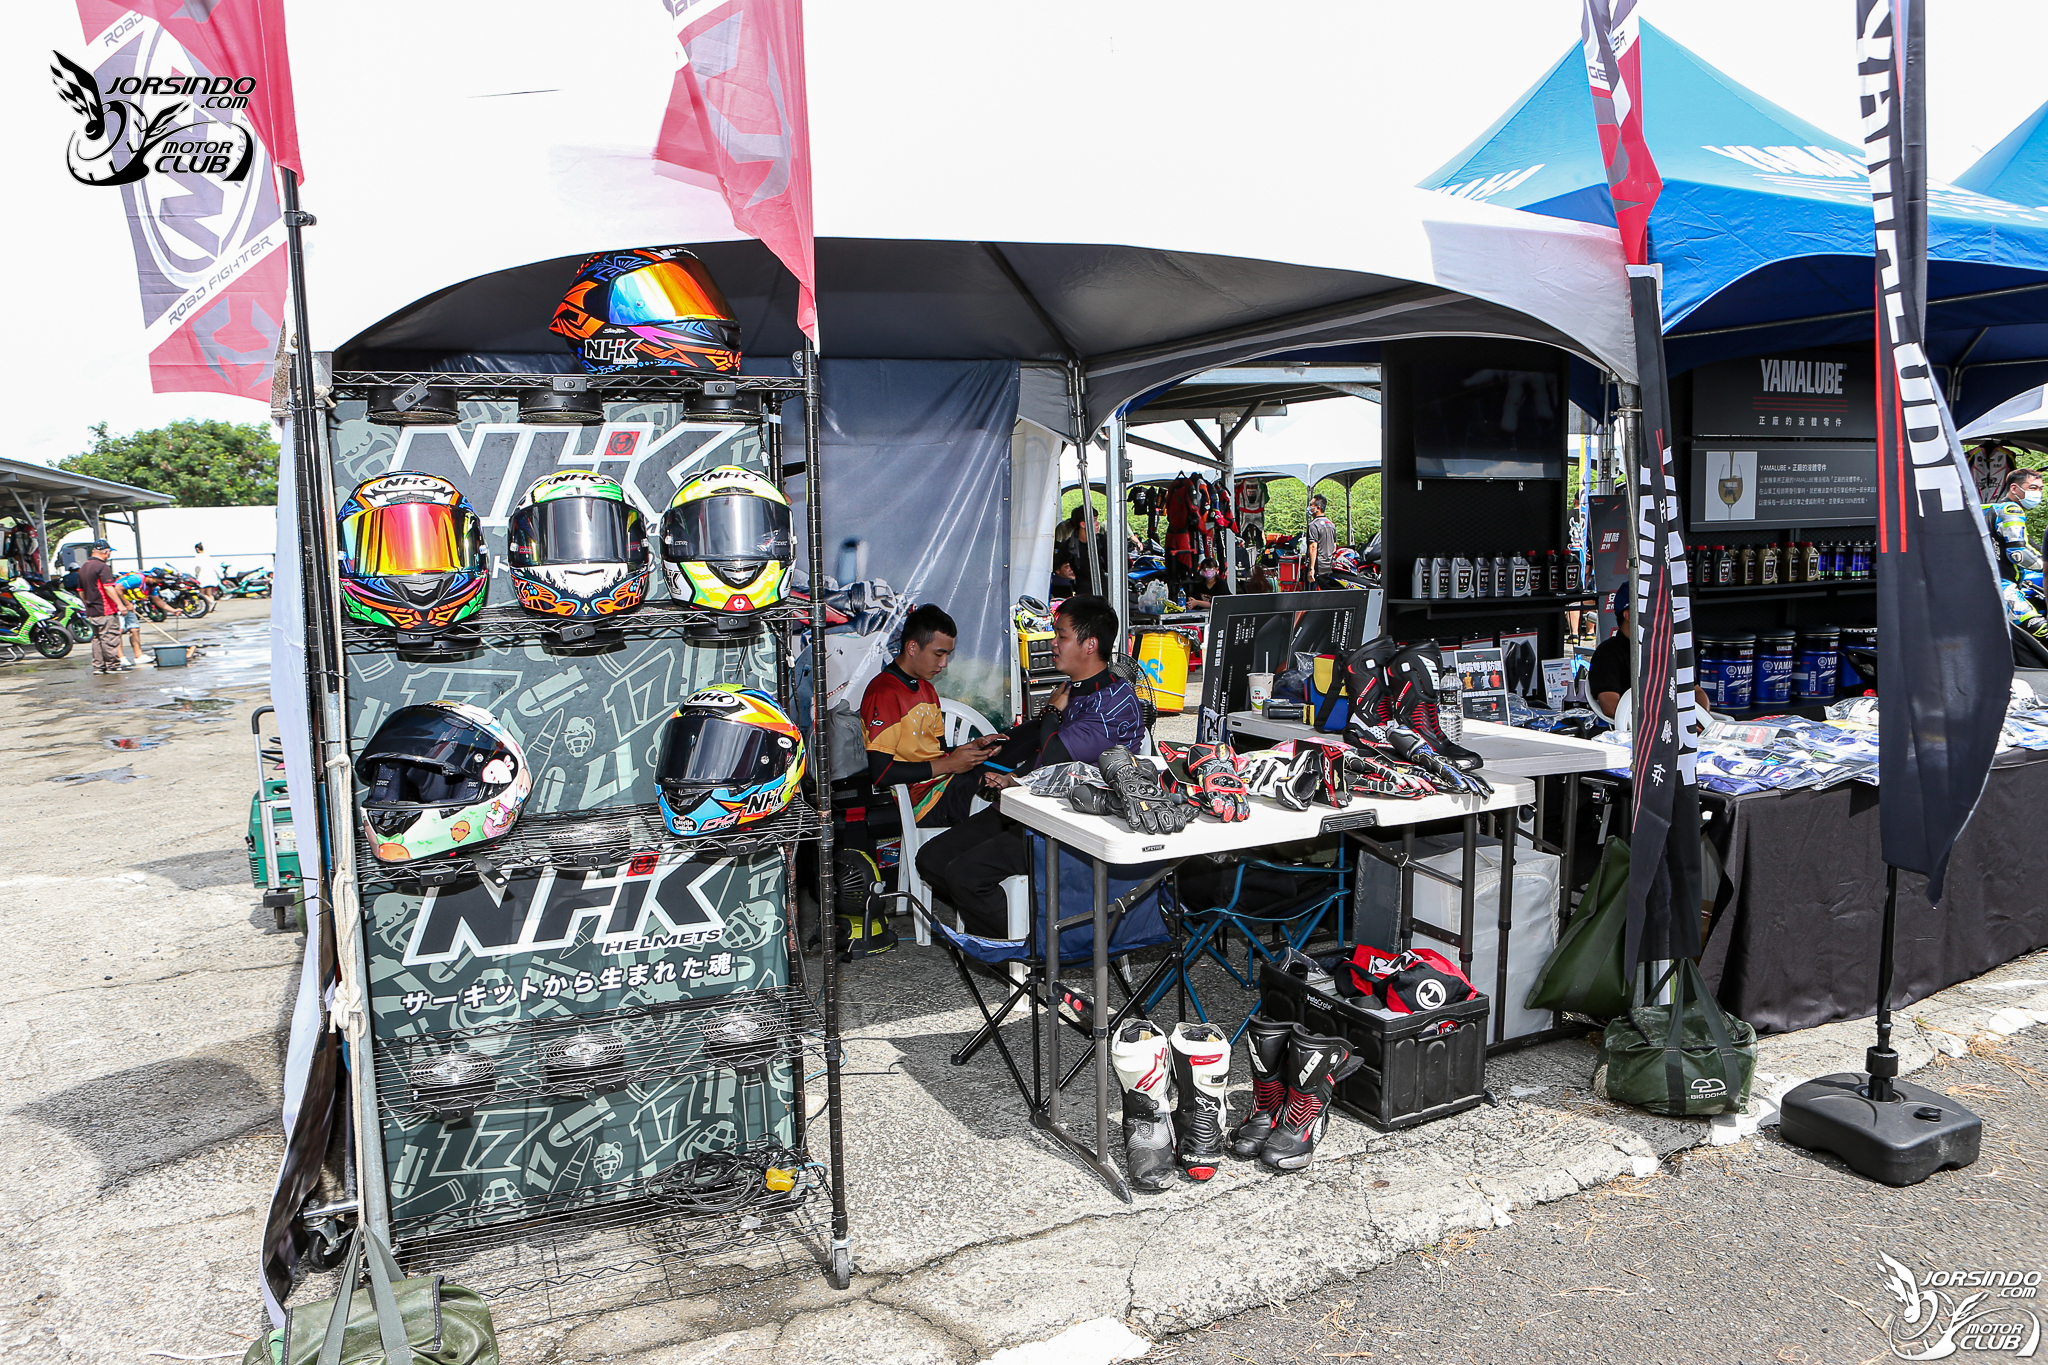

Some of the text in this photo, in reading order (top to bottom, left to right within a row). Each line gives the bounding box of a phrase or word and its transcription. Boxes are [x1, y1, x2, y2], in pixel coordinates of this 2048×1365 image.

[168, 235, 274, 325] ROAD FIGHTER
[584, 338, 644, 360] NHK
[1760, 358, 1844, 395] YAMALUBE
[383, 476, 431, 489] NHK
[385, 421, 746, 530] NHK
[552, 473, 602, 484] NHK
[708, 471, 751, 482] NHK
[687, 692, 731, 703] NHK
[745, 782, 790, 816] NHK
[402, 853, 736, 967] NHK
[601, 927, 725, 957] HELMETS
[402, 950, 735, 1017] サーキットから生まれた魂
[1704, 1089, 1728, 1099] DOME
